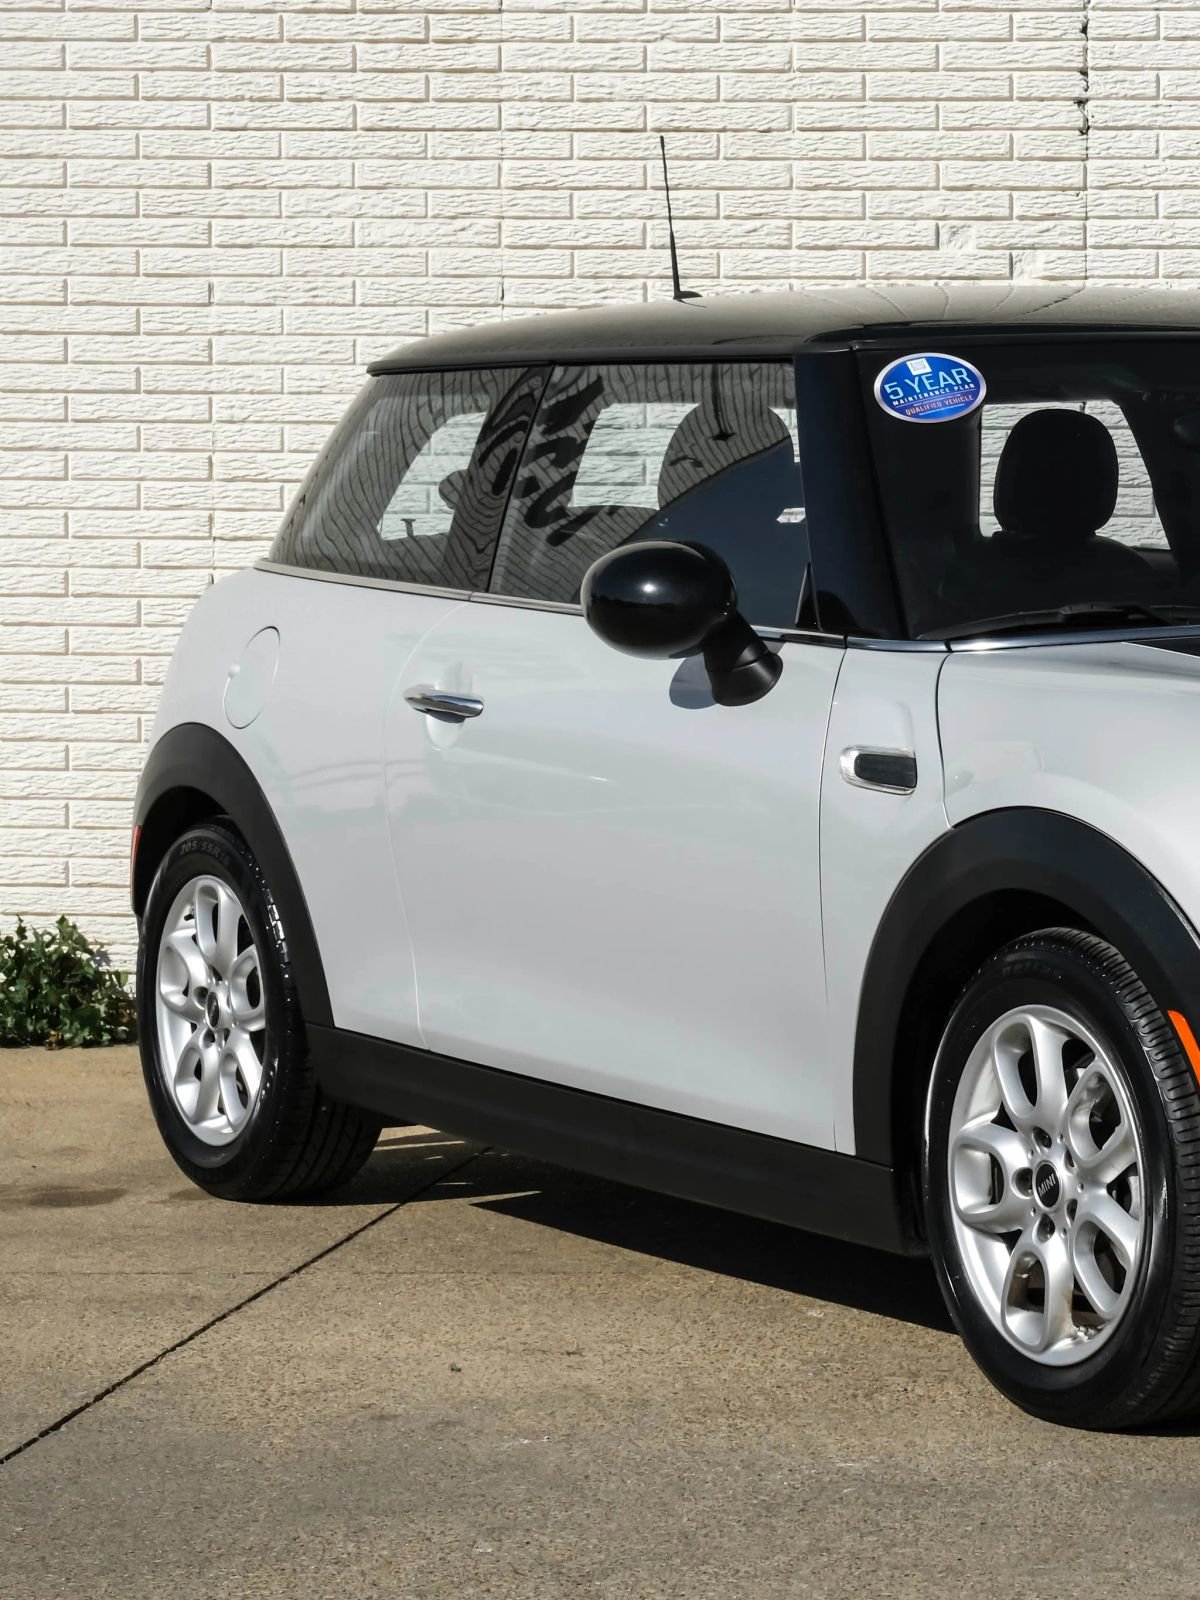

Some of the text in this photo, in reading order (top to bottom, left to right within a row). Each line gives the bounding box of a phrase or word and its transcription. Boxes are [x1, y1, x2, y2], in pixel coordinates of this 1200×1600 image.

[884, 381, 904, 400] 5
[904, 367, 972, 394] YEAR
[892, 388, 950, 407] MAINTENANCE
[953, 383, 976, 392] PLAN
[905, 401, 943, 416] QUALIFIED
[944, 394, 974, 406] VEHICLE
[1037, 1173, 1056, 1198] MINI
